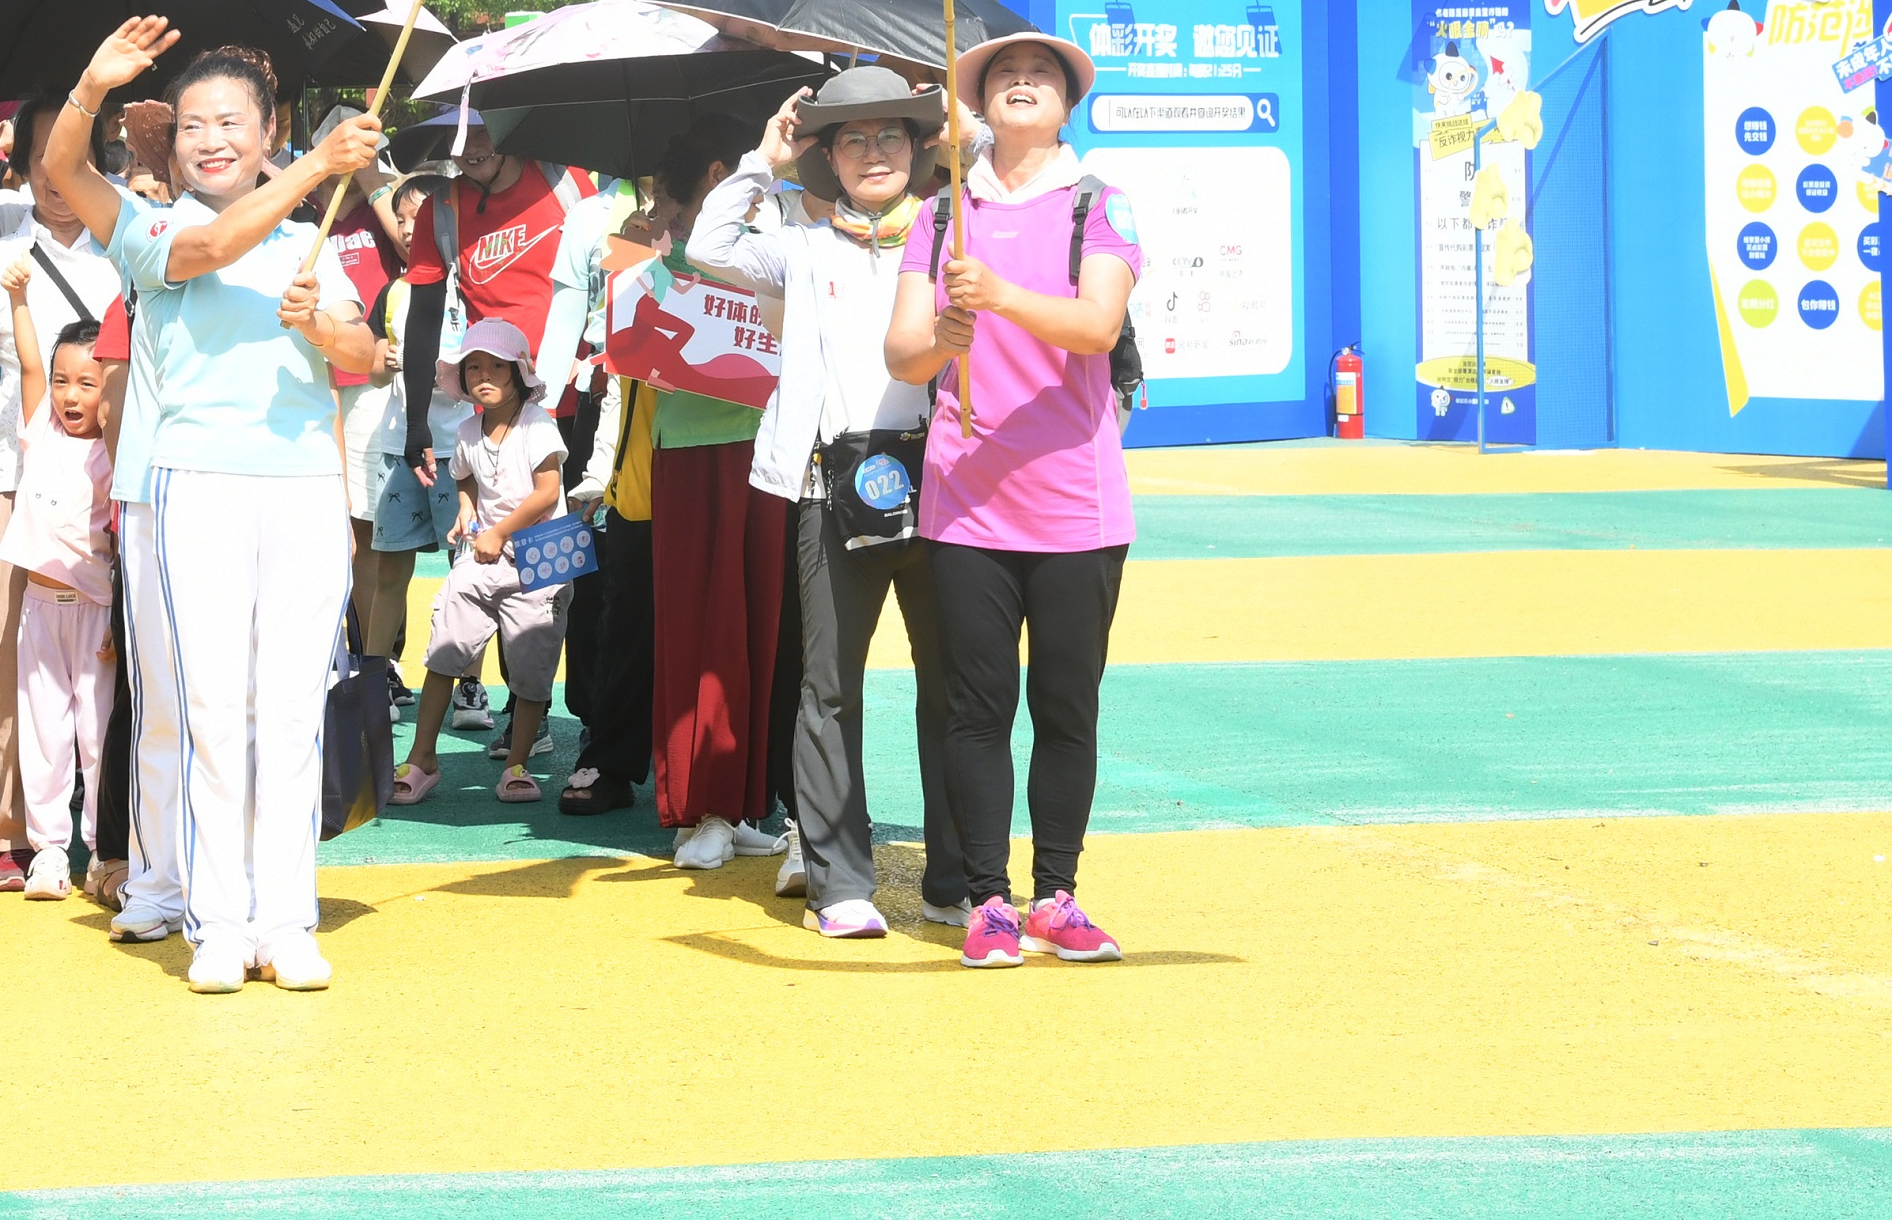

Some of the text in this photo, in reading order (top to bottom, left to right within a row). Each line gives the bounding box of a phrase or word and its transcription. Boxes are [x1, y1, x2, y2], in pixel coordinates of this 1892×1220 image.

[1089, 23, 1280, 58] 体彩开奖 邀您见证
[477, 224, 527, 262] NIKE
[1219, 245, 1243, 256] CMG
[1801, 299, 1836, 311] 包你赚钱
[733, 326, 782, 357] 好生
[864, 469, 905, 500] 022
